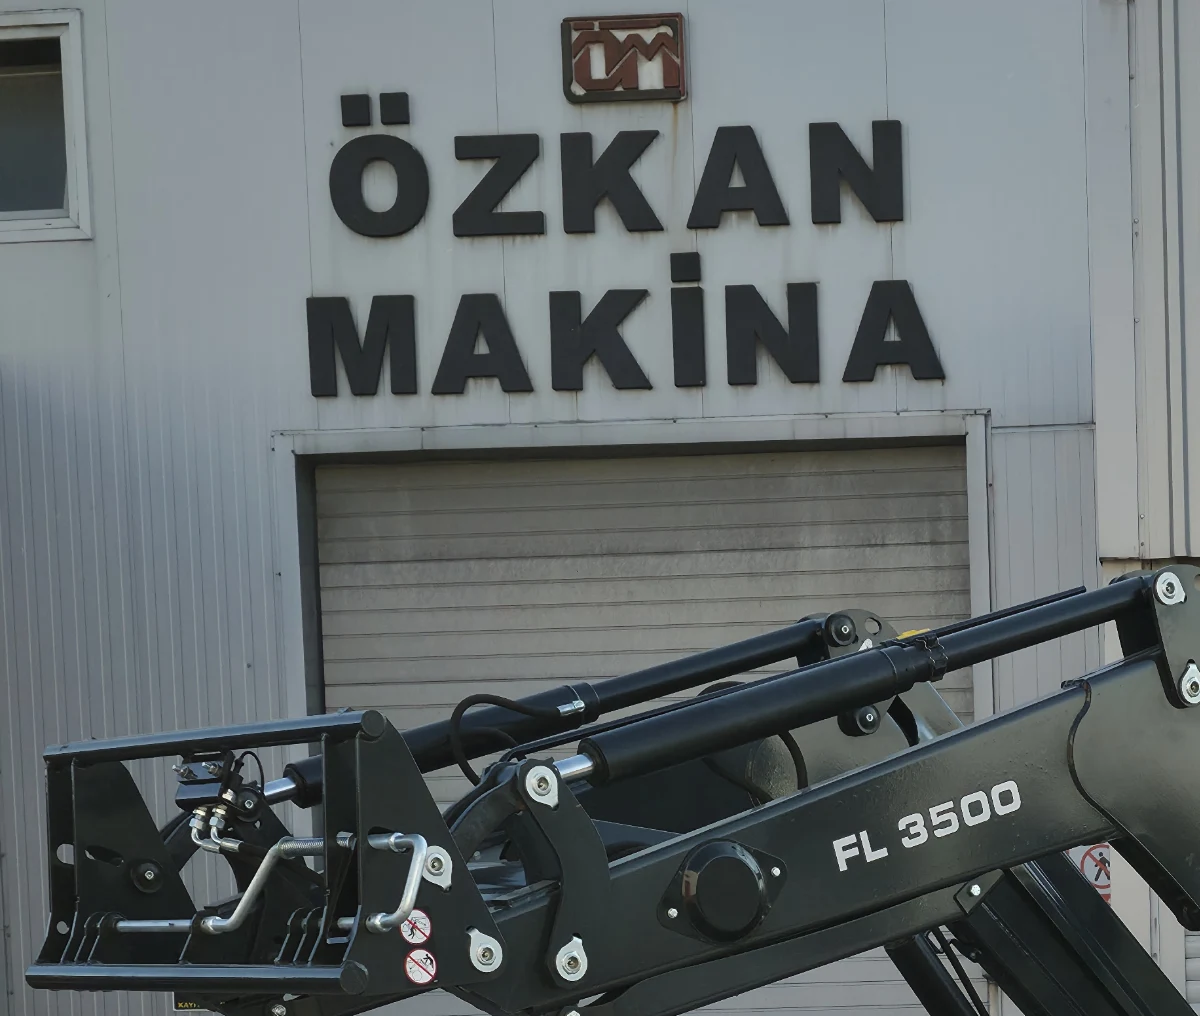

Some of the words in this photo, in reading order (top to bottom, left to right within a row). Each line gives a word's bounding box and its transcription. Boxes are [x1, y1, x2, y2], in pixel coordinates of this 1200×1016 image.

[329, 92, 904, 237] ÖZKAN
[306, 252, 945, 398] MAKİNA
[832, 830, 889, 872] FL
[898, 780, 1022, 849] 3500
